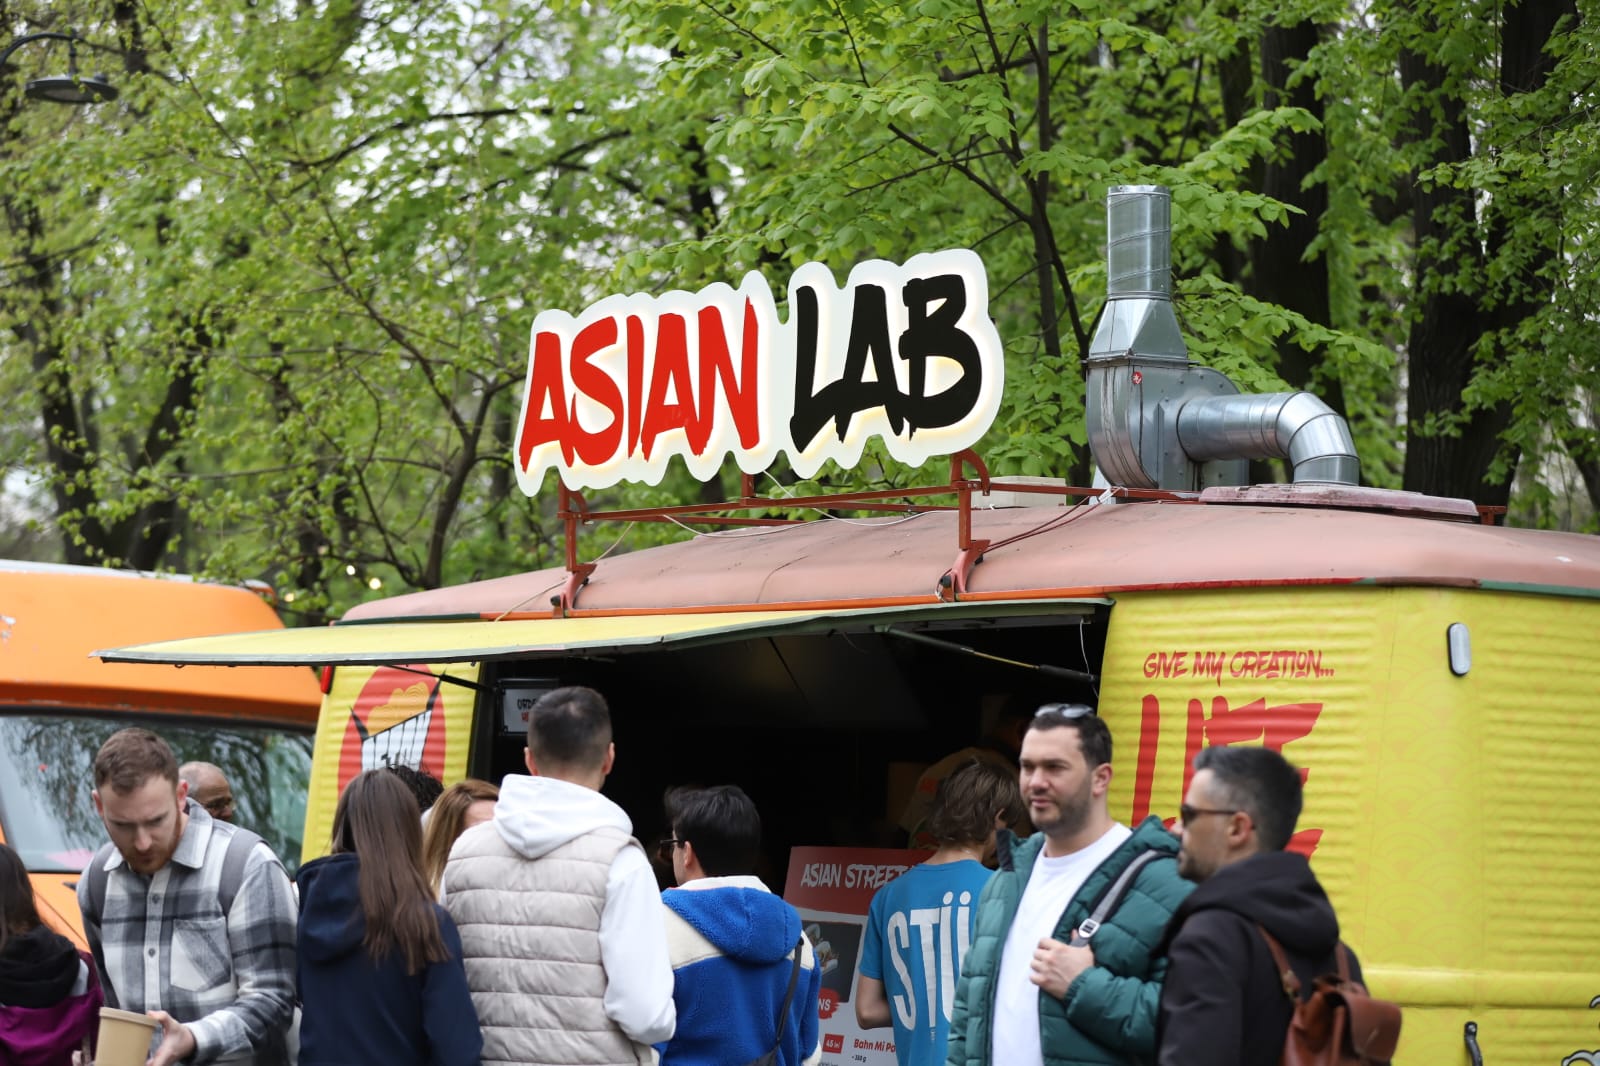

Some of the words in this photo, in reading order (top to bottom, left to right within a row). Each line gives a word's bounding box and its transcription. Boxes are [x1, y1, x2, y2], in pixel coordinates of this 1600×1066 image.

[519, 296, 760, 474] ASIAN
[789, 274, 983, 453] LAB
[1143, 651, 1188, 679] GIVE
[1192, 651, 1226, 687] MY
[1230, 650, 1335, 680] CREATION...
[800, 863, 842, 888] ASIAN
[853, 1038, 874, 1051] Bahn
[874, 1041, 886, 1052] Mi
